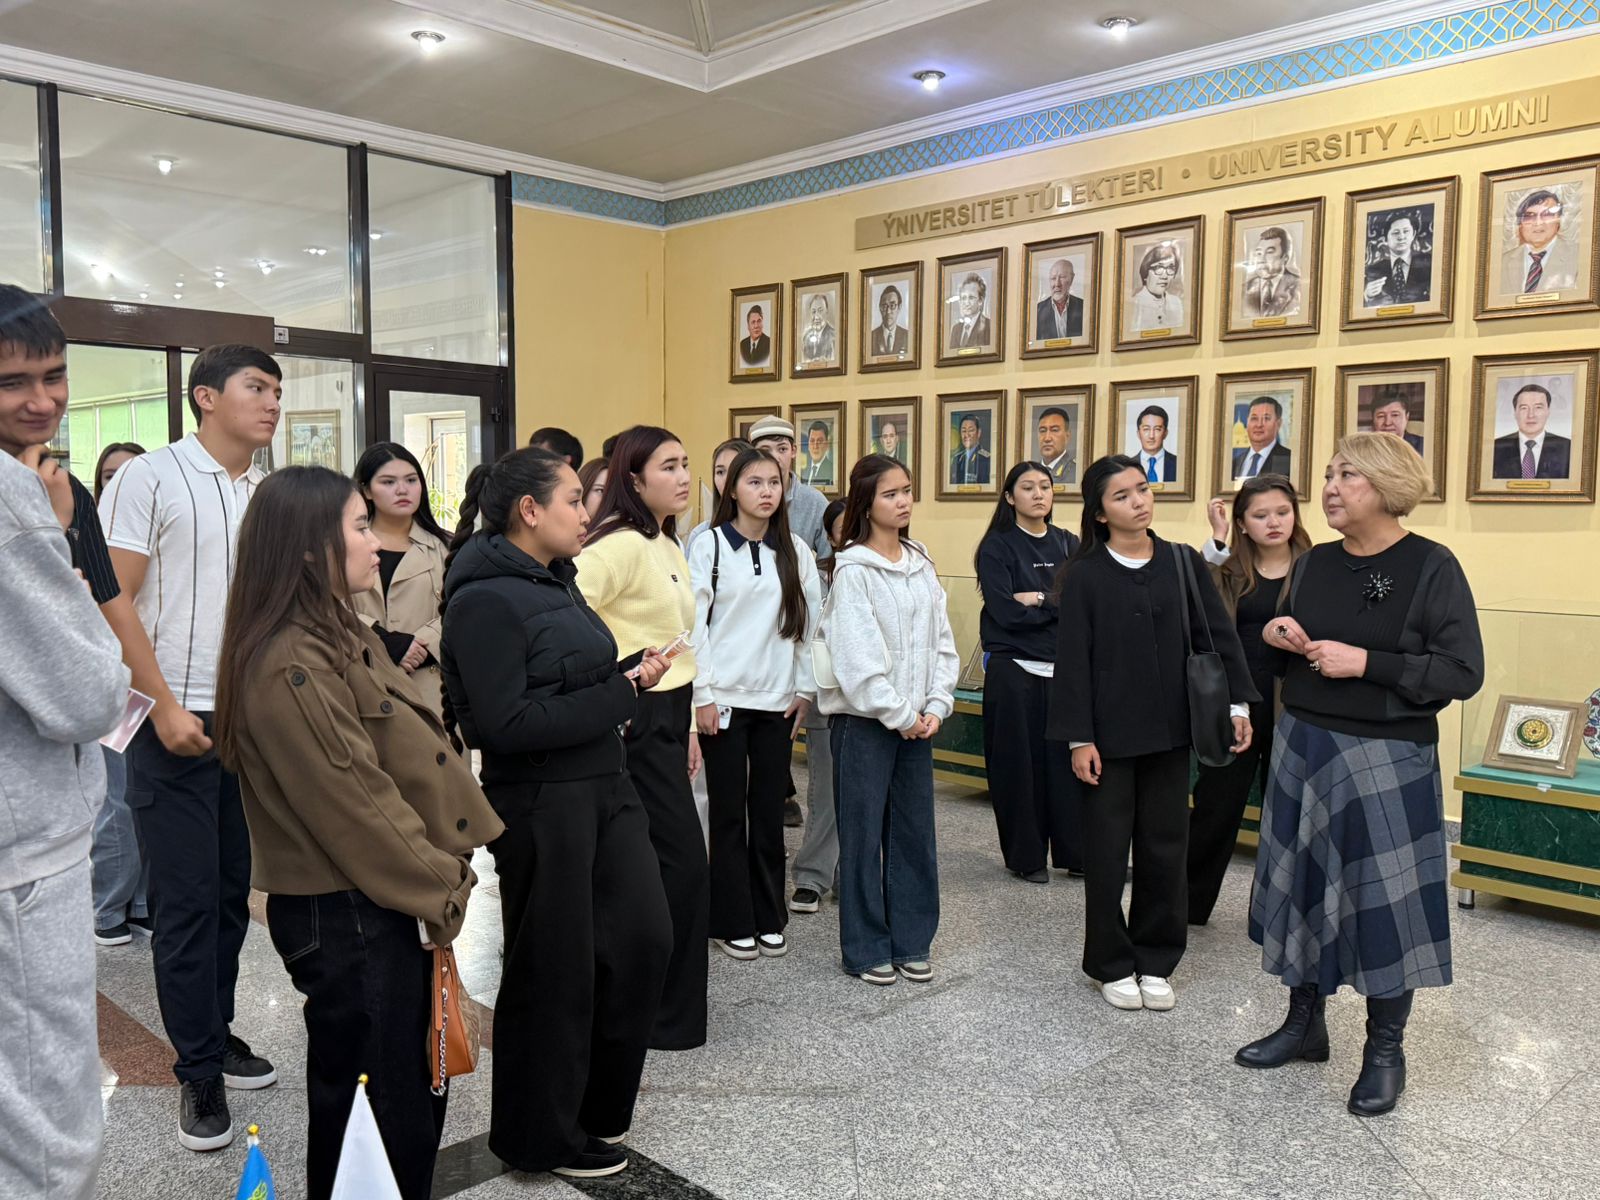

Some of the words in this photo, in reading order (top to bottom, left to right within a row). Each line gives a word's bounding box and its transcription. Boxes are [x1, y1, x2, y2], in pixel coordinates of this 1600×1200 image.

[882, 195, 1019, 239] ÝNIVERSITET
[1025, 166, 1164, 214] TÚLEKTERI
[1208, 122, 1398, 180] UNIVERSITY
[1404, 94, 1550, 147] ALUMNI
